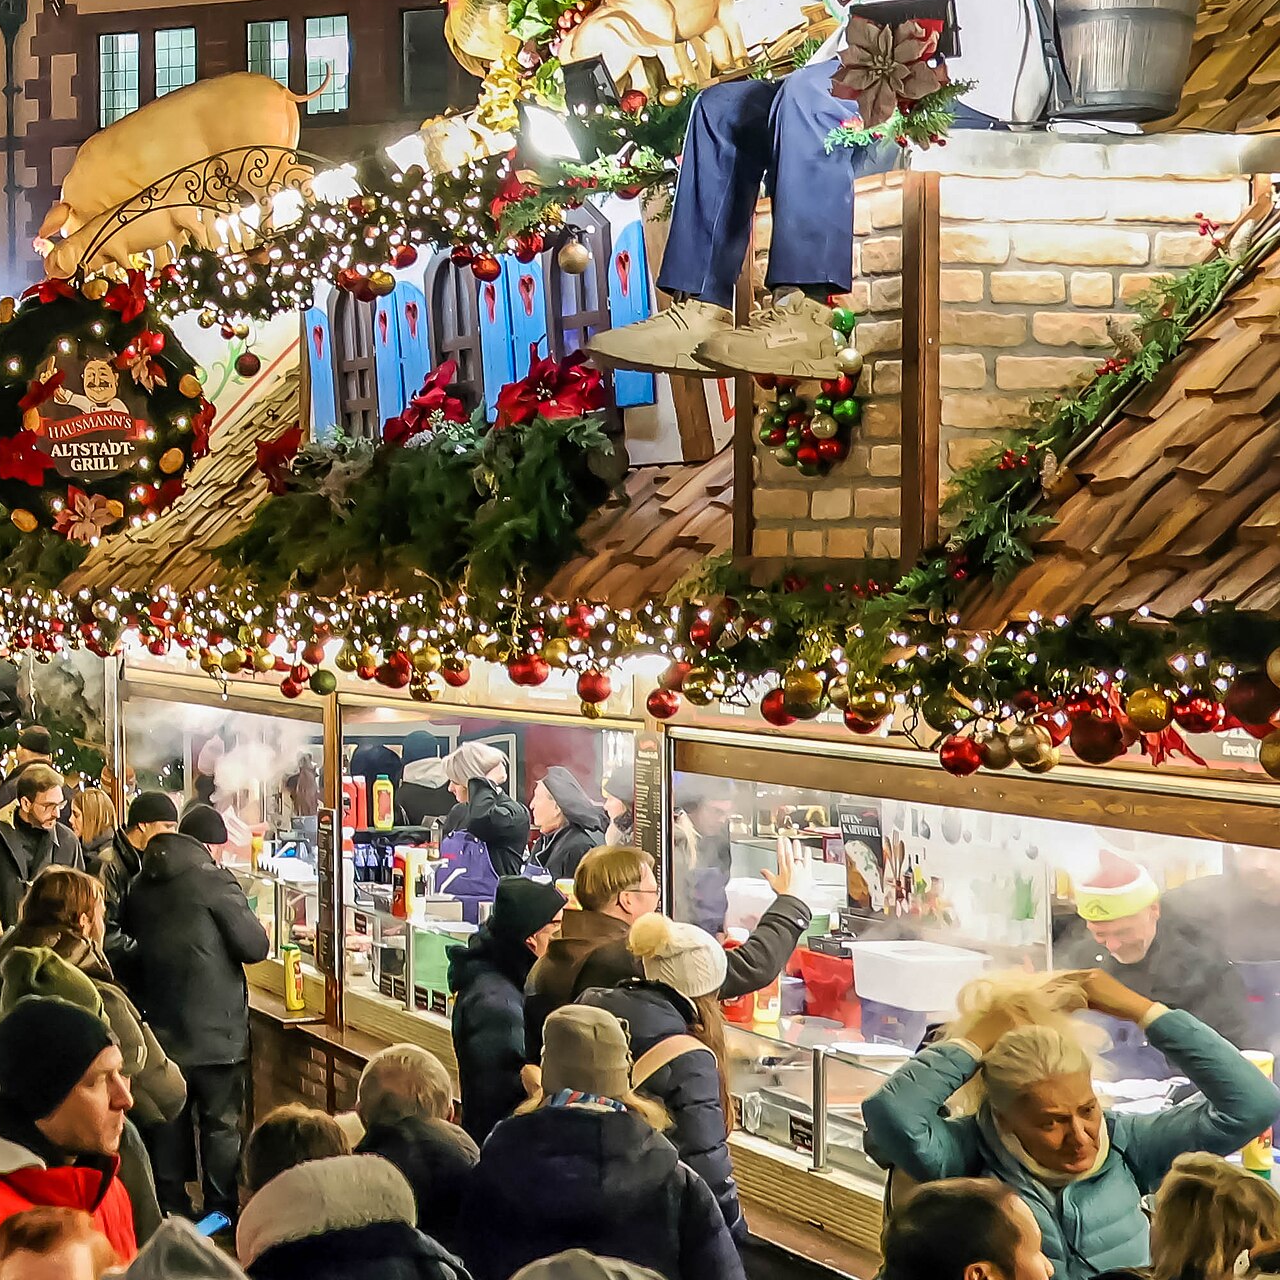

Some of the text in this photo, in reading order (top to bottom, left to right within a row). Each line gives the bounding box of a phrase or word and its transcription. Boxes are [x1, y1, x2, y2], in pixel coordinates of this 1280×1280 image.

[48, 414, 132, 439] HAUSMANN'S
[50, 440, 136, 458] ALTSTADT-
[70, 457, 119, 471] GRILL
